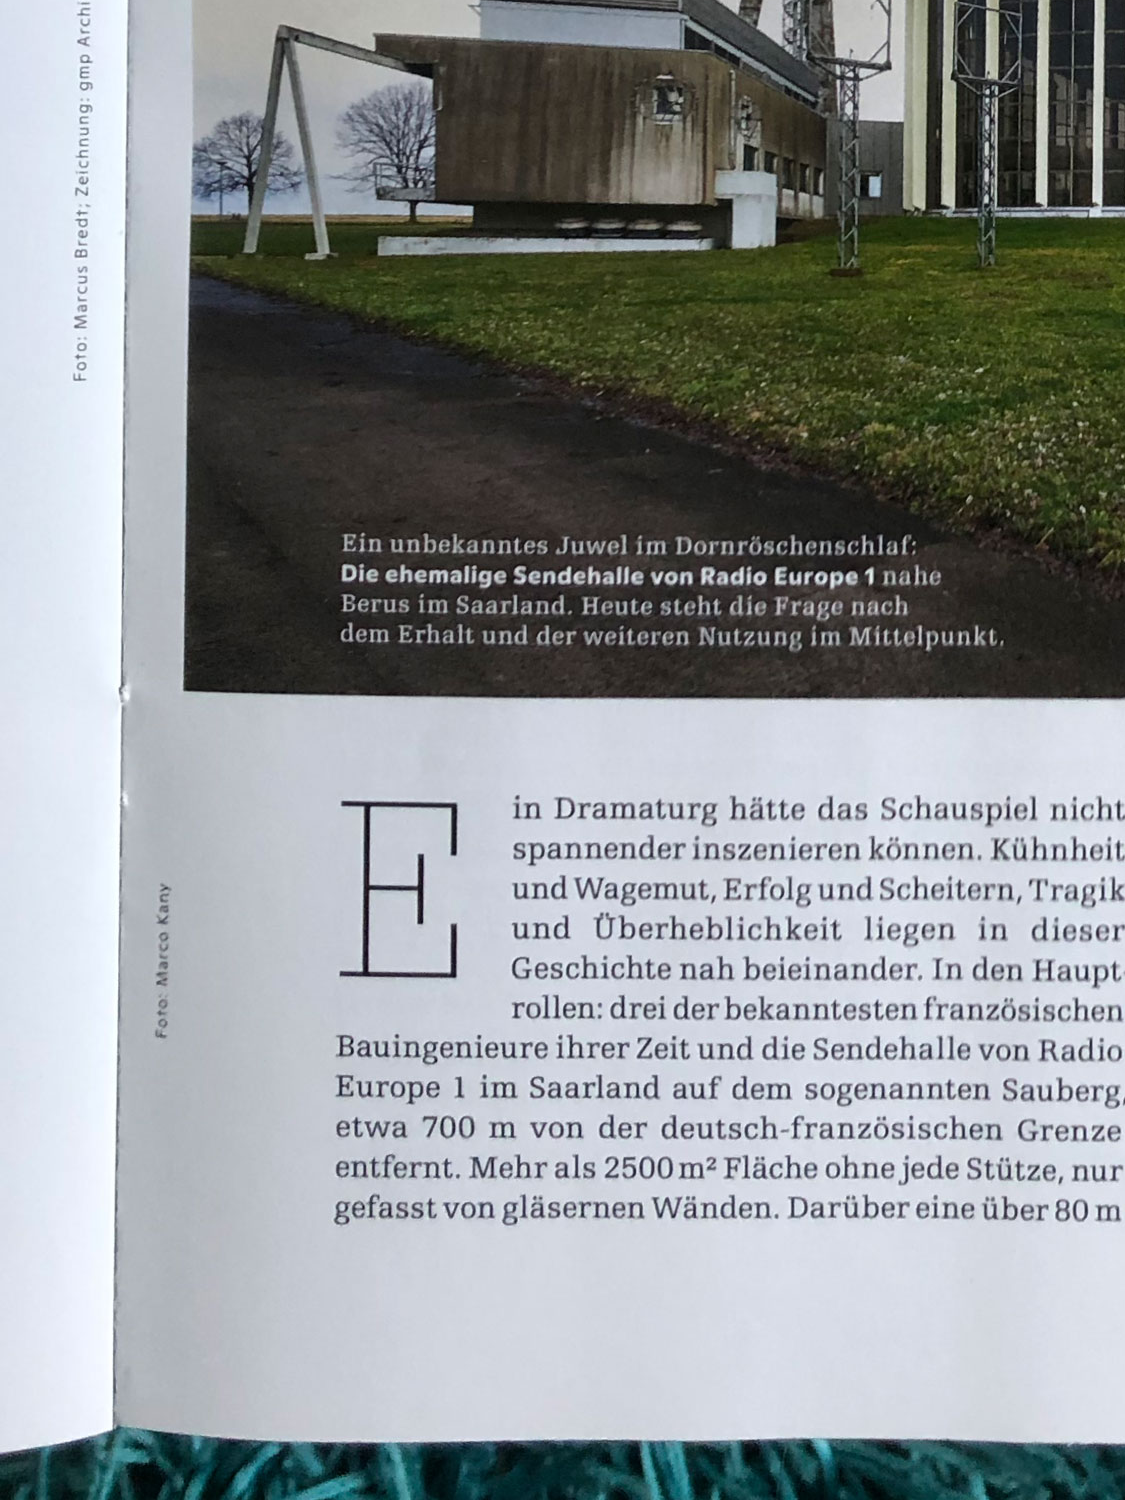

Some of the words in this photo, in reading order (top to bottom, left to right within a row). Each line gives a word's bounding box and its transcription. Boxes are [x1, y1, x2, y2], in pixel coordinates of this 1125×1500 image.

[79, 53, 94, 92] gmp
[74, 94, 94, 197] Zeichnung:
[73, 203, 92, 259] Bredt;
[73, 265, 89, 330] Marcus
[72, 336, 88, 382] Foto:
[342, 532, 382, 553] Ein
[390, 533, 548, 555] unbekanntes
[555, 534, 627, 556] Juwel
[636, 534, 667, 556] im
[675, 534, 917, 556] Dornröschenschlaf:
[341, 563, 379, 583] Die
[384, 564, 507, 589] ehemalige
[513, 565, 645, 586] Sendehalle
[650, 570, 694, 586] von
[700, 565, 768, 586] Radio
[774, 566, 859, 590] Europe
[864, 566, 875, 586] 1
[882, 564, 942, 586] nahe
[341, 593, 410, 614] Berus
[418, 593, 449, 614] im
[456, 594, 573, 615] Saarland.
[581, 596, 653, 616] Heute
[660, 595, 722, 616] steht
[729, 594, 767, 616] die
[775, 596, 843, 621] Frage
[851, 594, 909, 616] nach
[340, 621, 390, 644] dem
[398, 623, 475, 645] Erhalt
[482, 624, 529, 646] und
[535, 624, 577, 647] der
[582, 625, 690, 647] weiteren
[698, 626, 803, 652] Nutzung
[810, 625, 841, 647] im
[849, 624, 1005, 652] Mittelpunkt.
[513, 794, 542, 820] in
[554, 796, 718, 827] Dramaturg
[729, 795, 806, 821] hätte
[817, 795, 868, 821] das
[880, 794, 1038, 828] Schauspiel
[1050, 795, 1125, 822] nicht
[156, 882, 173, 926] Kany
[512, 874, 568, 900] und
[574, 877, 717, 907] Wagemut,
[723, 876, 812, 908] Erfolg
[818, 875, 873, 901] und
[879, 875, 1022, 905] Scheitern,
[1028, 876, 1125, 909] Tragik
[155, 931, 170, 987] Marco
[511, 954, 672, 981] Geschichte
[679, 955, 735, 981] nah
[743, 955, 923, 982] beieinander.
[933, 957, 963, 981] In
[972, 955, 1023, 982] den
[154, 993, 169, 1040] Foto:
[335, 1033, 549, 1066] Bauingenieure
[556, 1034, 631, 1060] ihrer
[636, 1035, 691, 1060] Zeit
[697, 1035, 754, 1061] und
[761, 1035, 806, 1061] die
[813, 1035, 971, 1061] Sendehalle
[978, 1043, 1030, 1062] von
[1039, 1037, 1123, 1063] Radio
